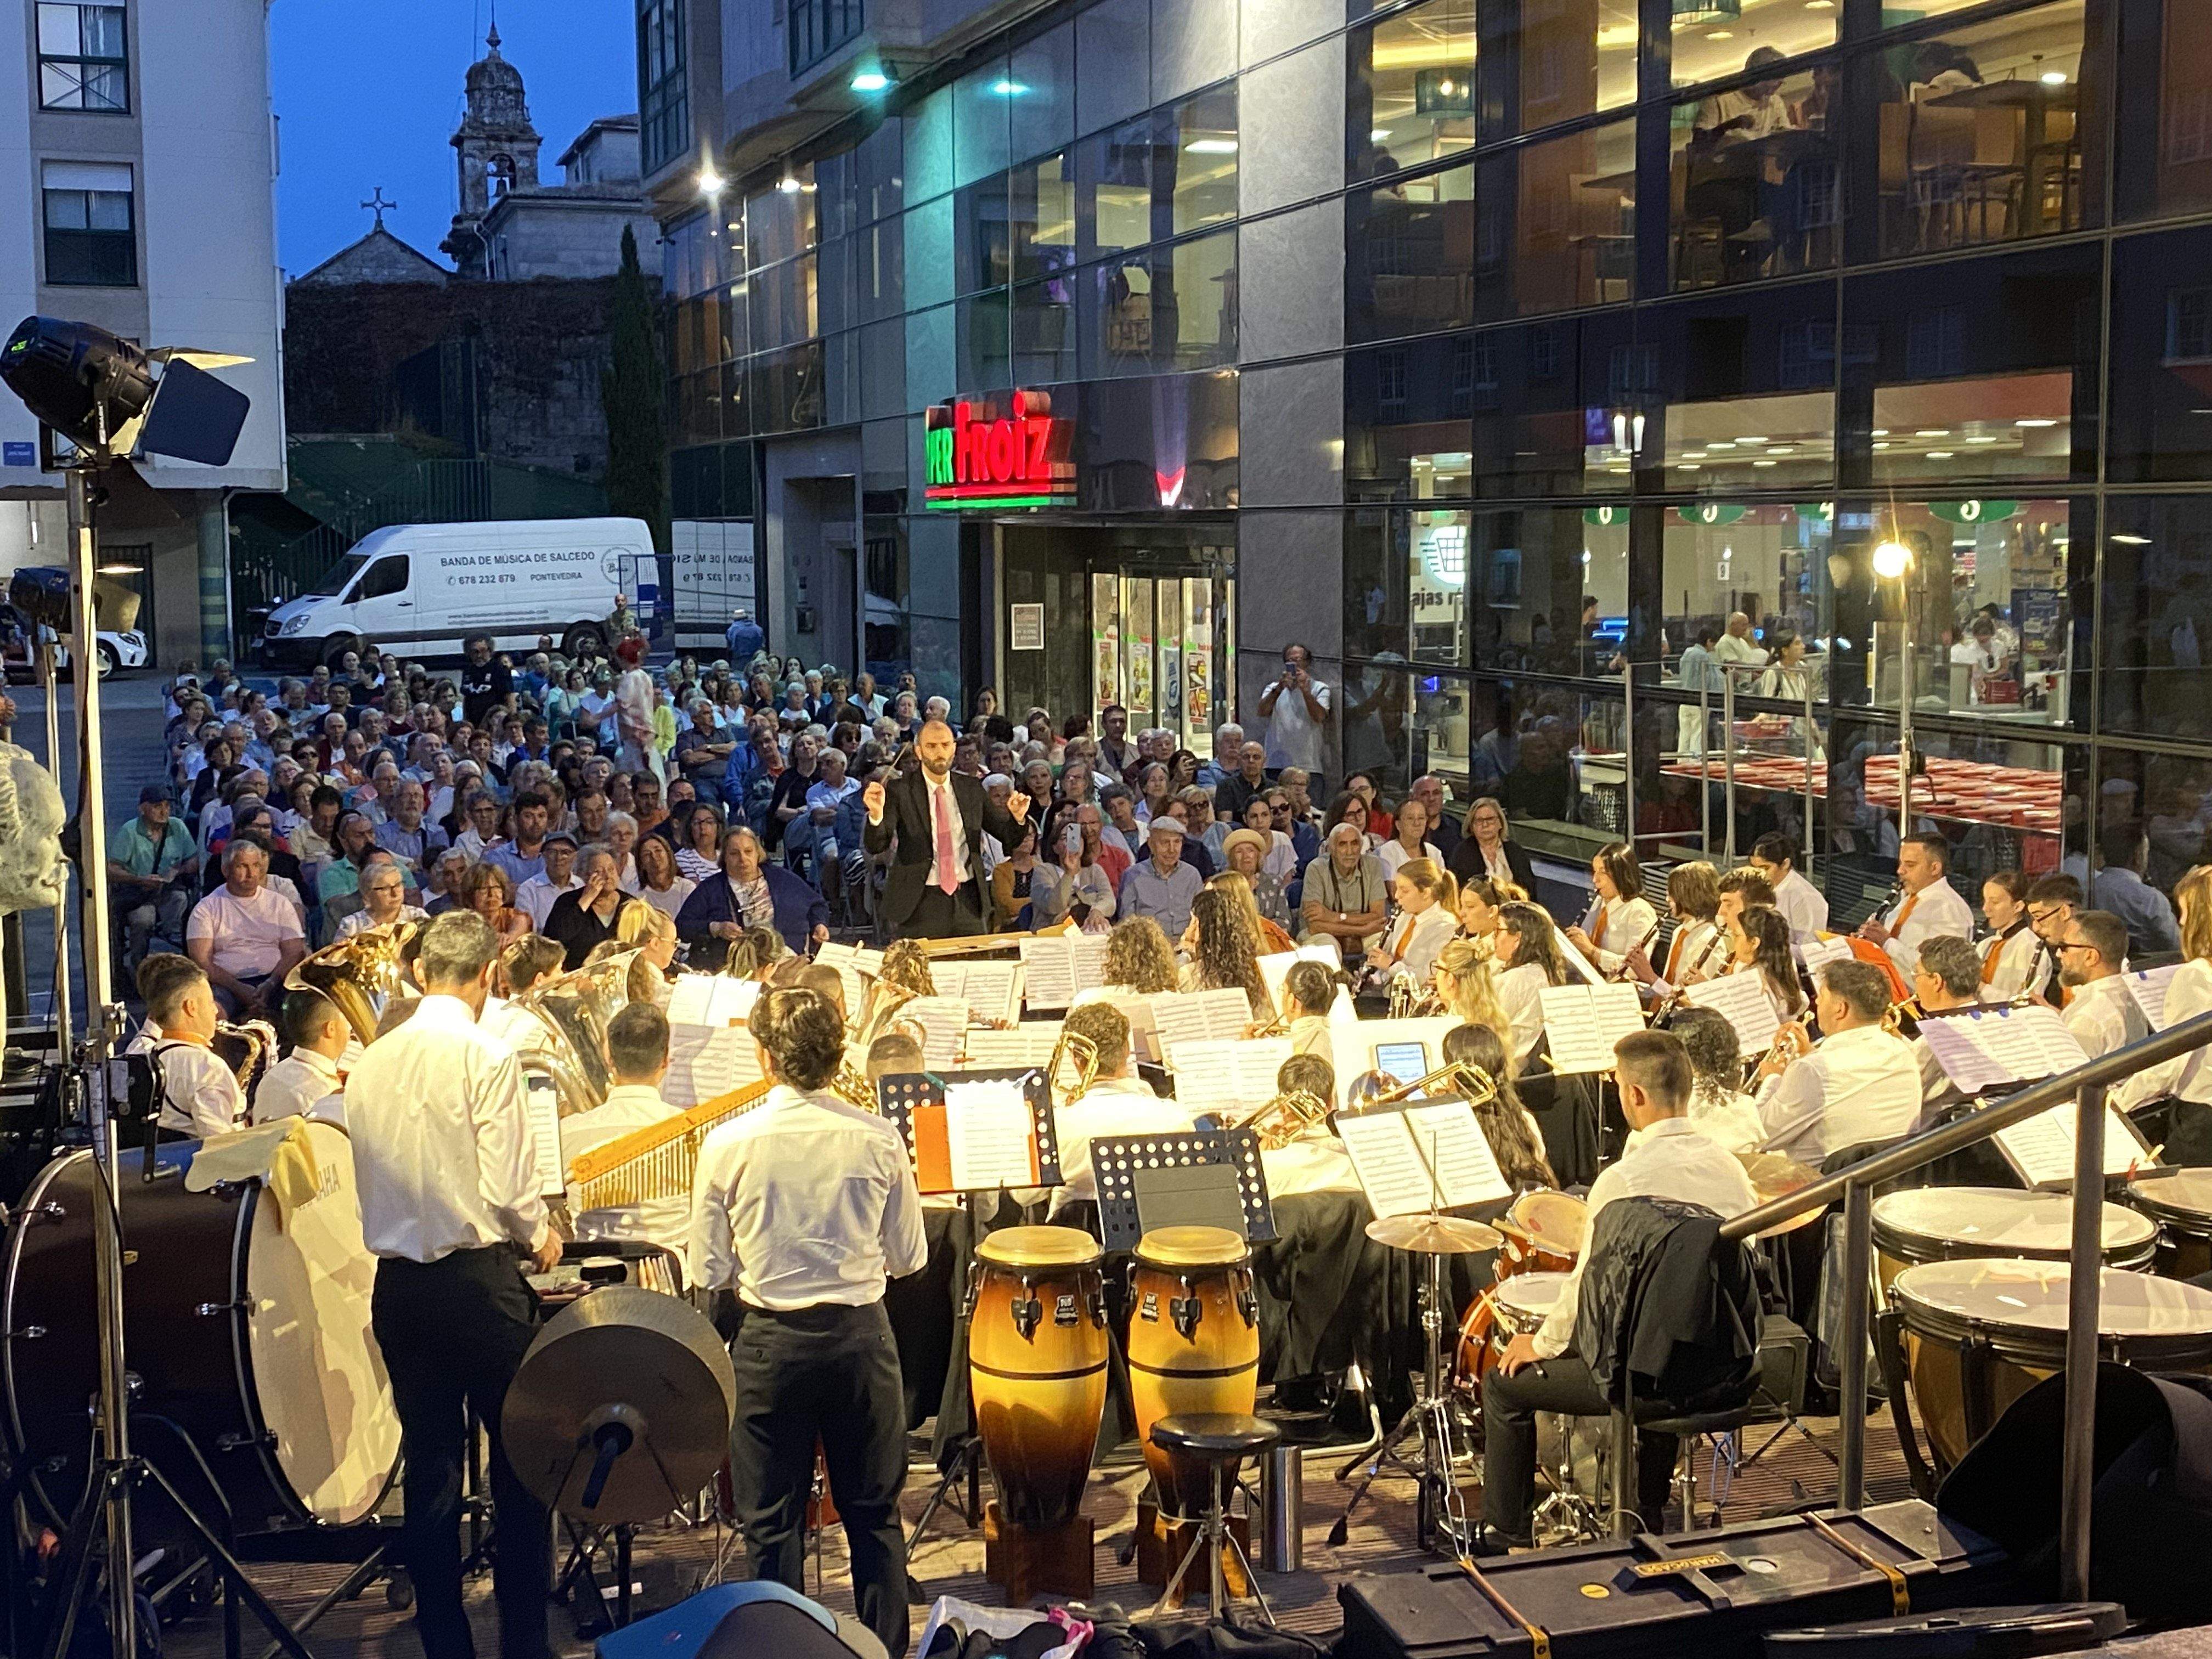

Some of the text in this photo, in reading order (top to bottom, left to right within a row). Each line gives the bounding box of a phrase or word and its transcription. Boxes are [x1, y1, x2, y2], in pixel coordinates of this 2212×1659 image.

[441, 551, 595, 567] BANDA DE MÚSICA DE SALCEDO
[459, 575, 476, 585] 678
[479, 574, 496, 584] 232
[530, 572, 583, 581] PONTEVEDRA
